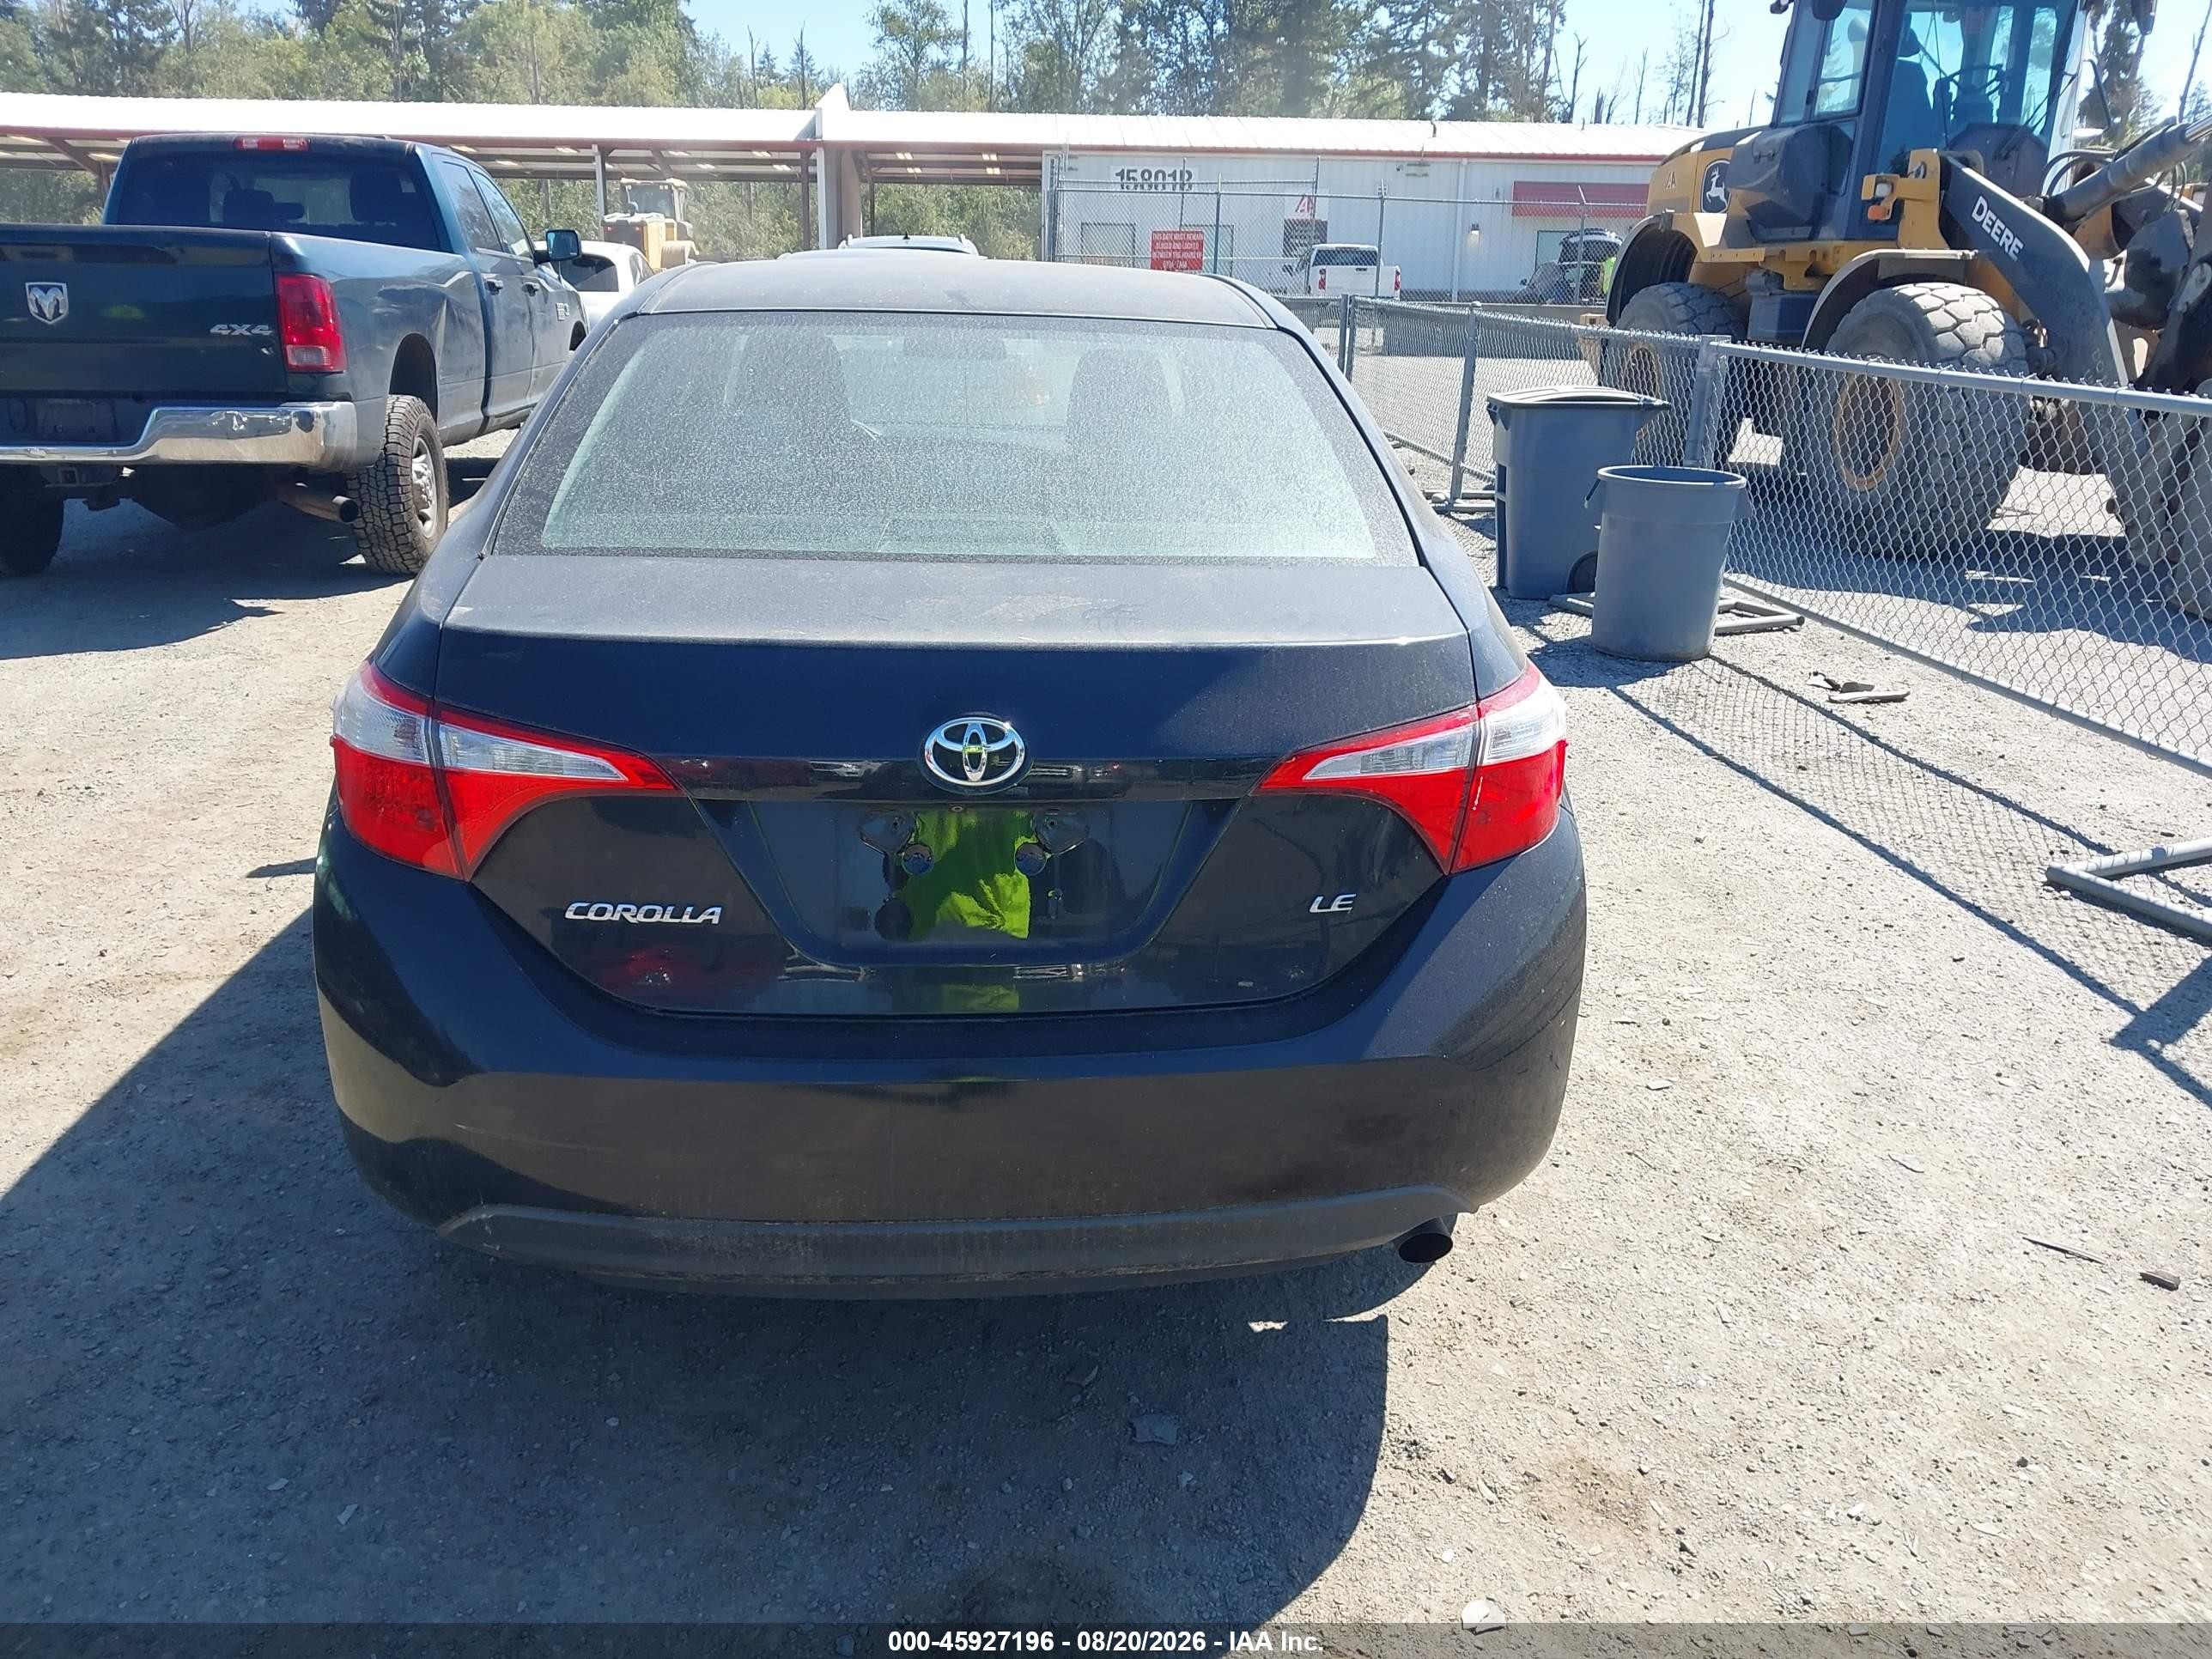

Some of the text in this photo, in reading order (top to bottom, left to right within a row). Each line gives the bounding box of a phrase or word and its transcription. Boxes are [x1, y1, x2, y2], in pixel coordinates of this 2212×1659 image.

[1972, 195, 2024, 262] DEERE
[565, 902, 722, 924] COROLLA
[1310, 893, 1357, 913] LE
